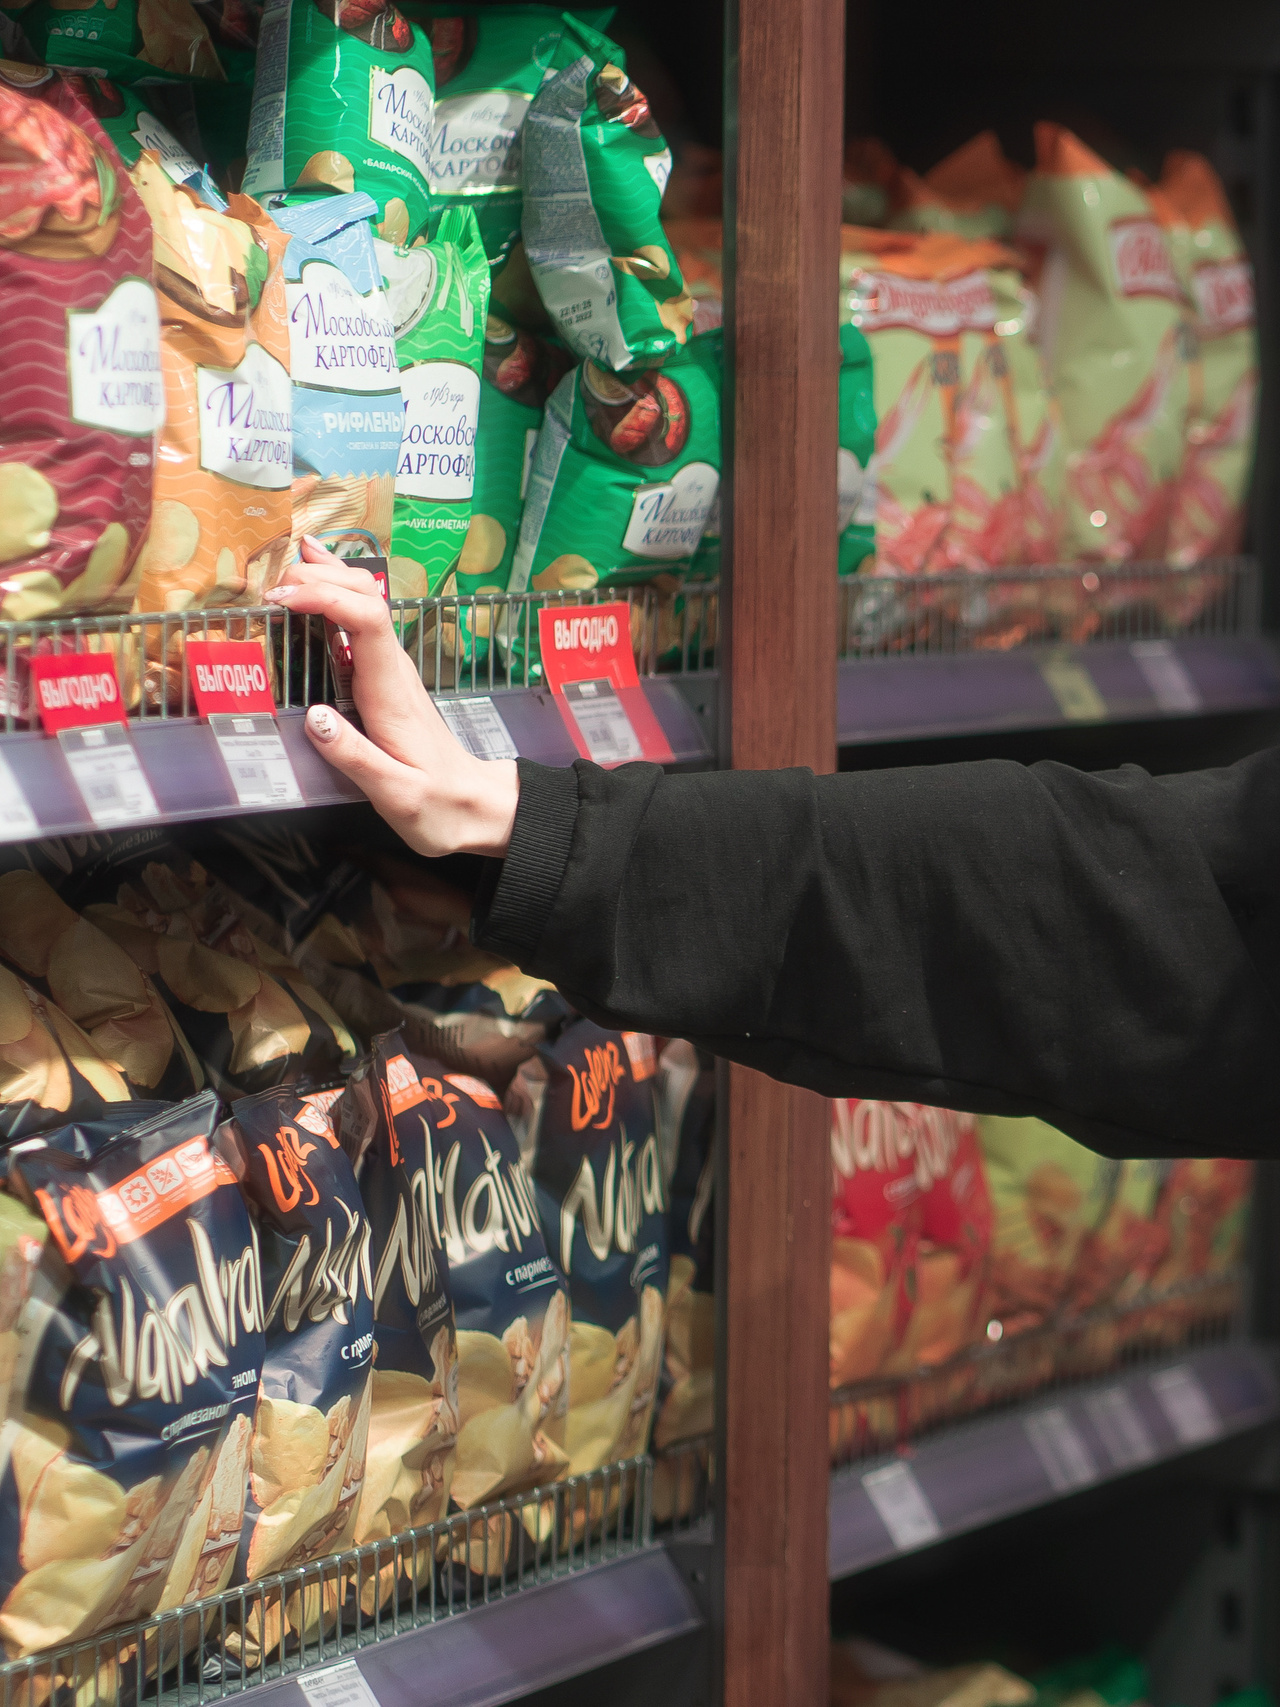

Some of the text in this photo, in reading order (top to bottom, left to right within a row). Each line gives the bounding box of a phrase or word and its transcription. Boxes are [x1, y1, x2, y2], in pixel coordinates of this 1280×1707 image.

[314, 344, 400, 374] КАРТОФЕЛ
[323, 411, 405, 435] РИФЛЕНЫ
[554, 614, 619, 653] ВЫГОДНО
[39, 672, 118, 710] ВЫГОДНО
[195, 664, 267, 697] ВЫГОДНО
